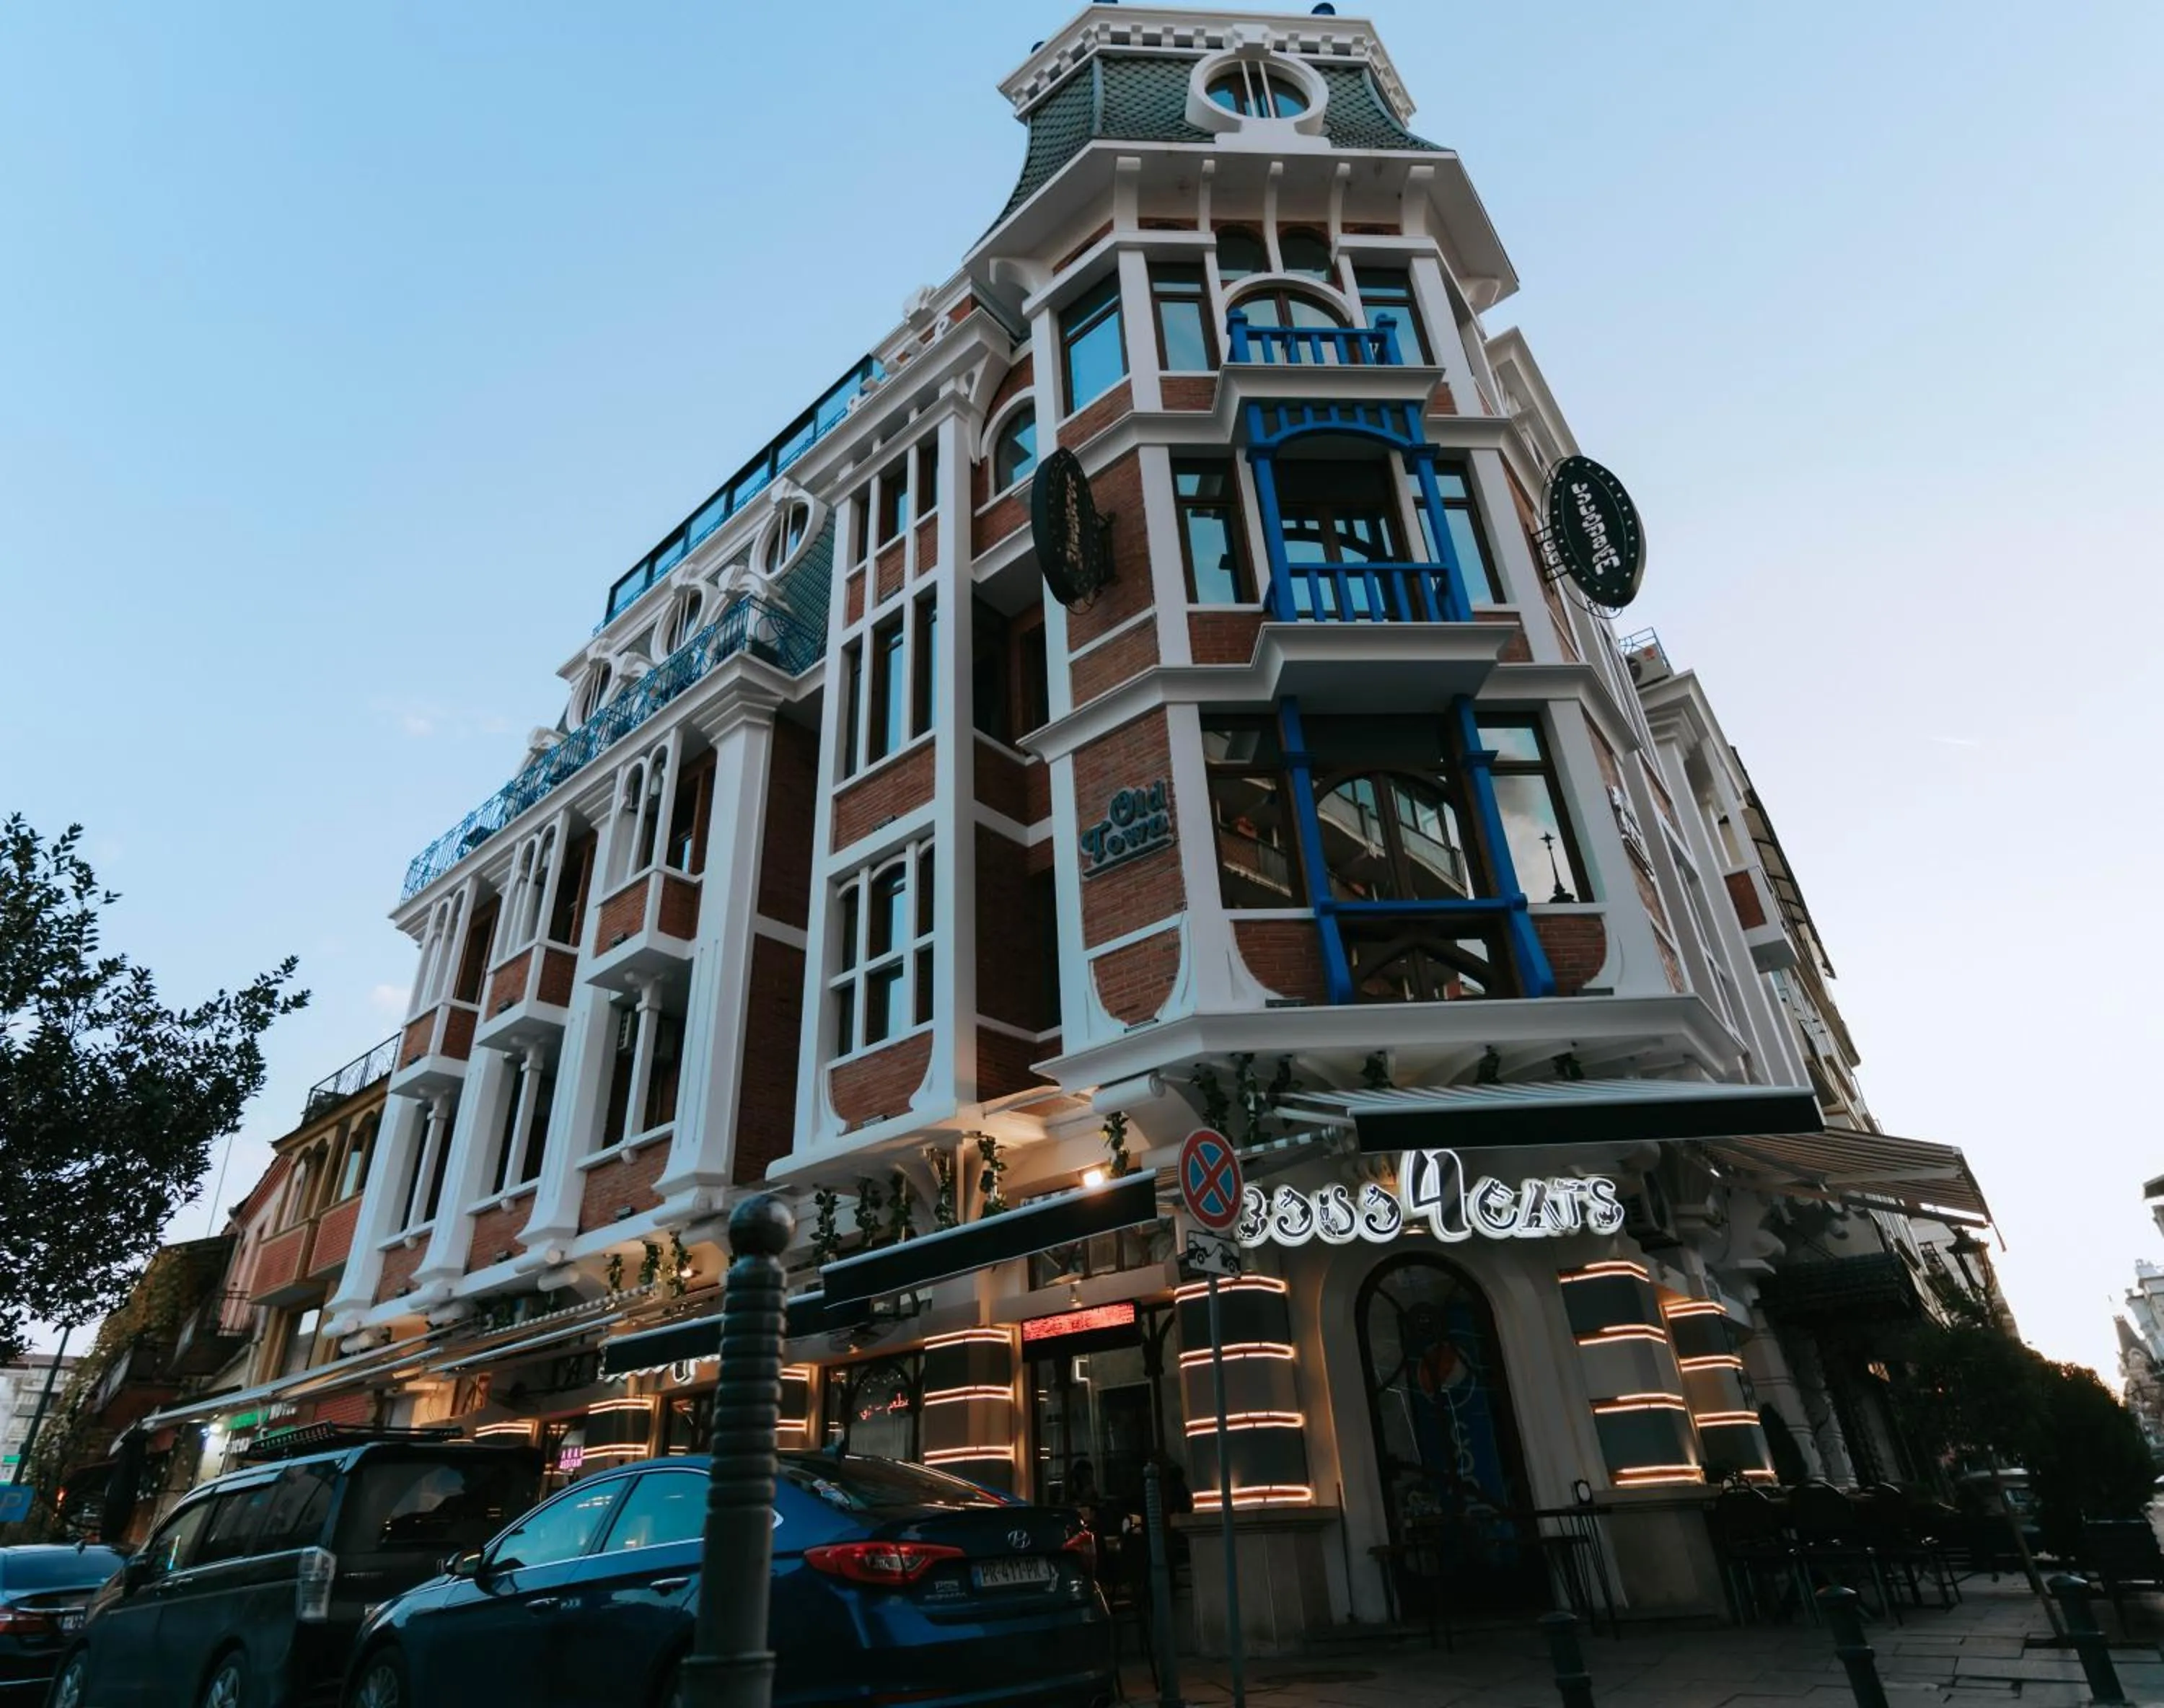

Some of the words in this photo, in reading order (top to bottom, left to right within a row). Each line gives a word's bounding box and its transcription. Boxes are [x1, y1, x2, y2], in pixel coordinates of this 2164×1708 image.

[1109, 779, 1166, 827] Old
[1081, 815, 1170, 863] Town
[1467, 1176, 1624, 1239] CATS
